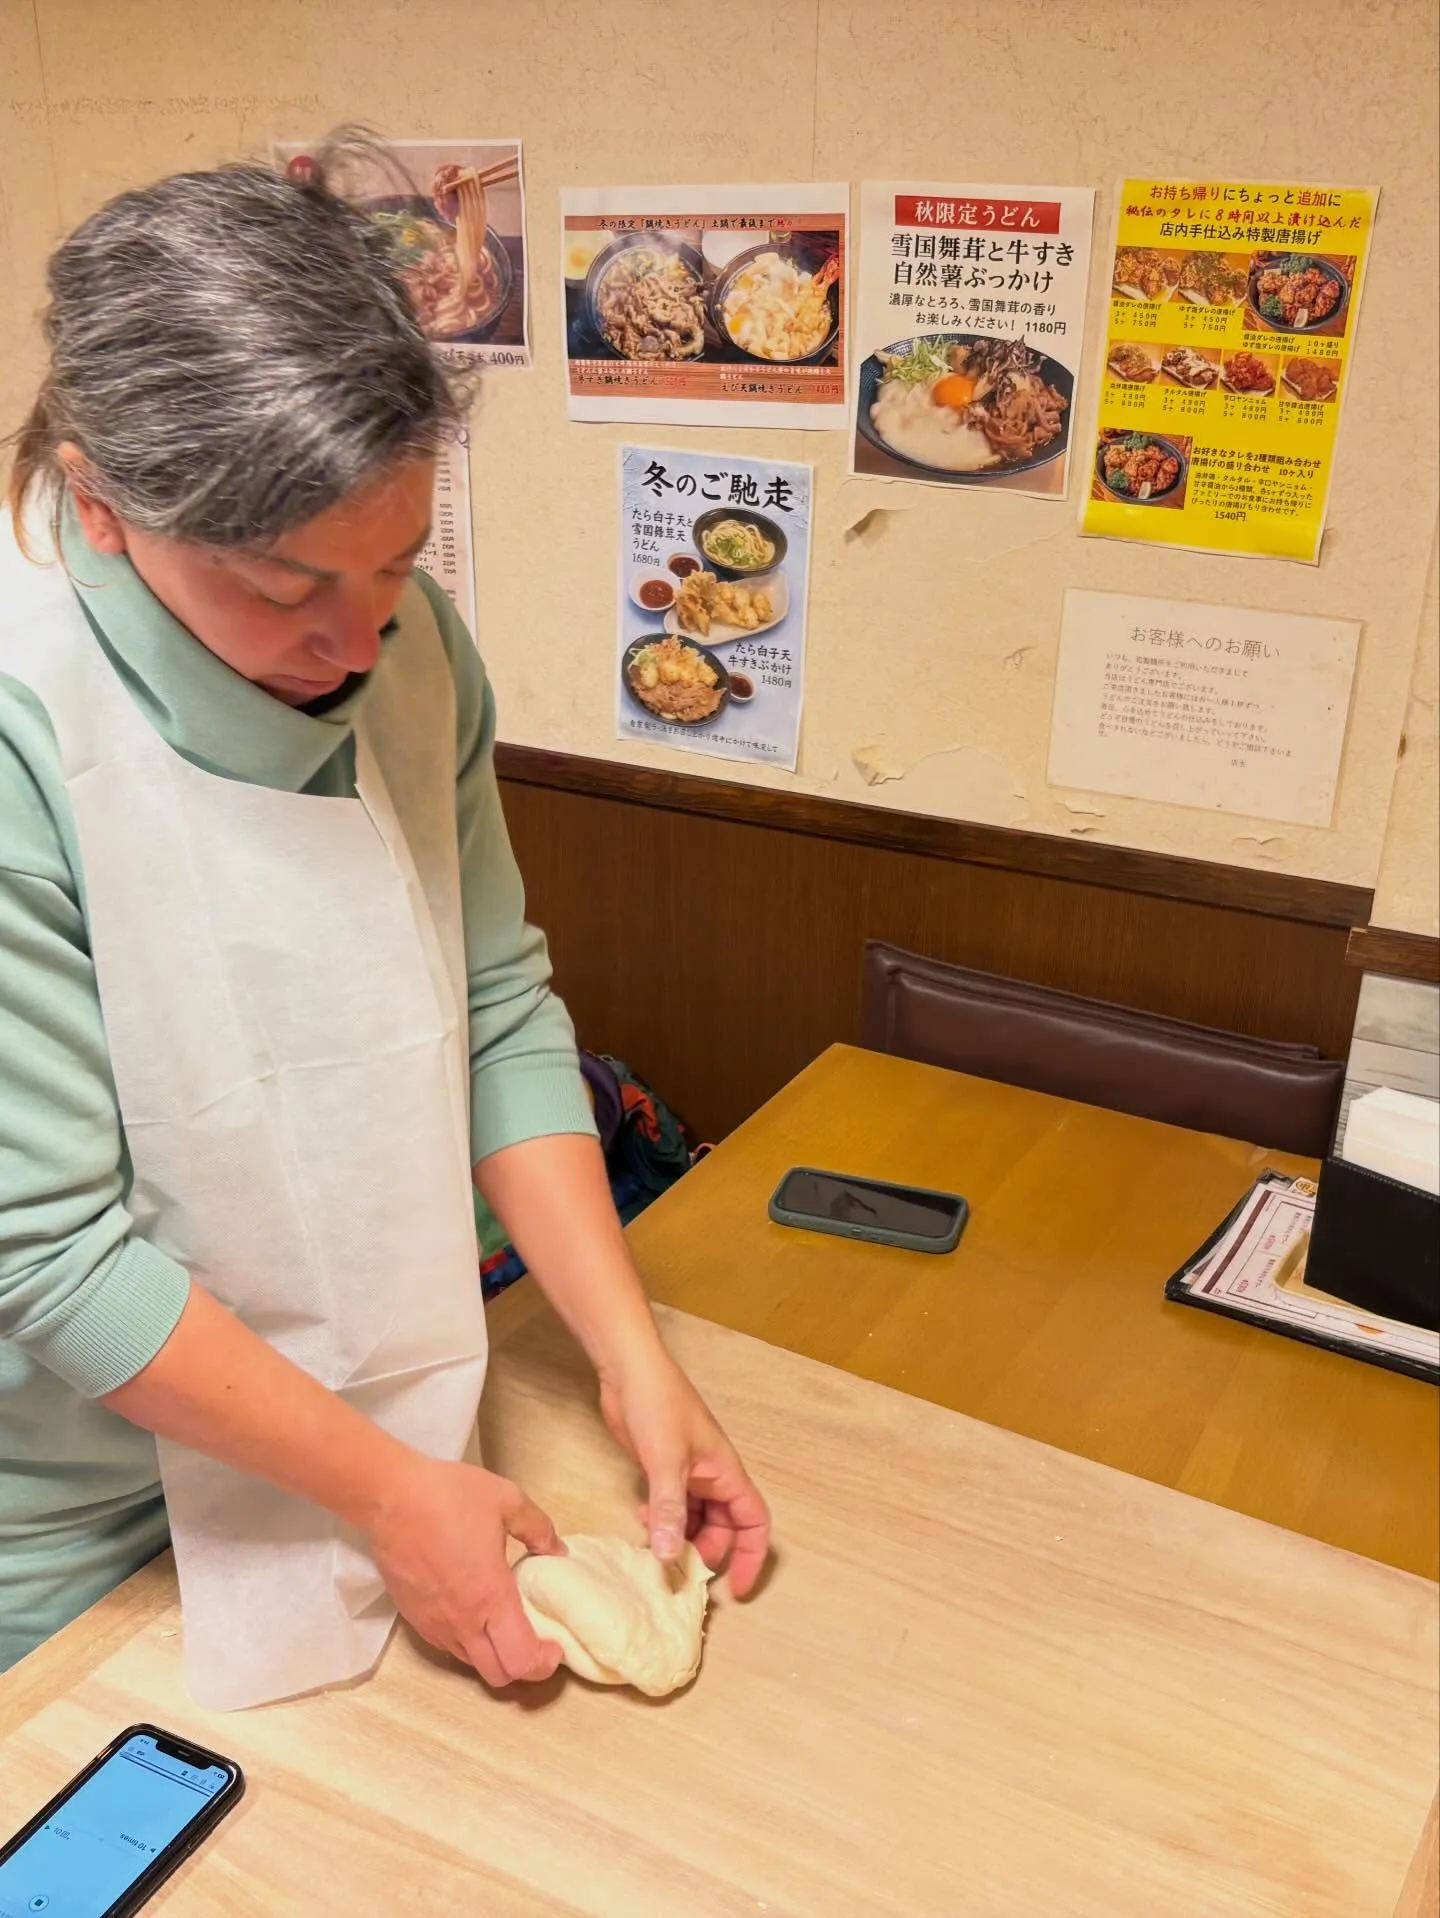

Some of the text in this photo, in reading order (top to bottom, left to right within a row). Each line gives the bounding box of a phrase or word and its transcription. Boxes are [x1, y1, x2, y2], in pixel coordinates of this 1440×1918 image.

[1150, 185, 1341, 208] お持ち帰りにちょっと追加に
[915, 200, 1040, 228] 秋限定うどん
[1159, 222, 1322, 246] 店内手仕込み特製唐揚げ
[891, 233, 1075, 267] 雪国舞茸と牛すき
[893, 260, 1054, 294] 自然薯ぶっかけ
[888, 292, 1056, 317] 濃厚なとろろ、雪国舞茸の香り
[1025, 321, 1067, 336] 1180円
[490, 351, 524, 365] 400円
[641, 460, 795, 513] 冬のご馳走
[632, 508, 693, 528] たら白子天と
[1215, 511, 1246, 521] 1540円
[631, 523, 686, 542] 雪国舞茸天
[632, 537, 660, 552] うどん
[632, 552, 660, 567] 1680円
[736, 640, 792, 662] たら白子天
[1130, 626, 1280, 659] お客様へのお願い
[761, 674, 792, 688] 1480円
